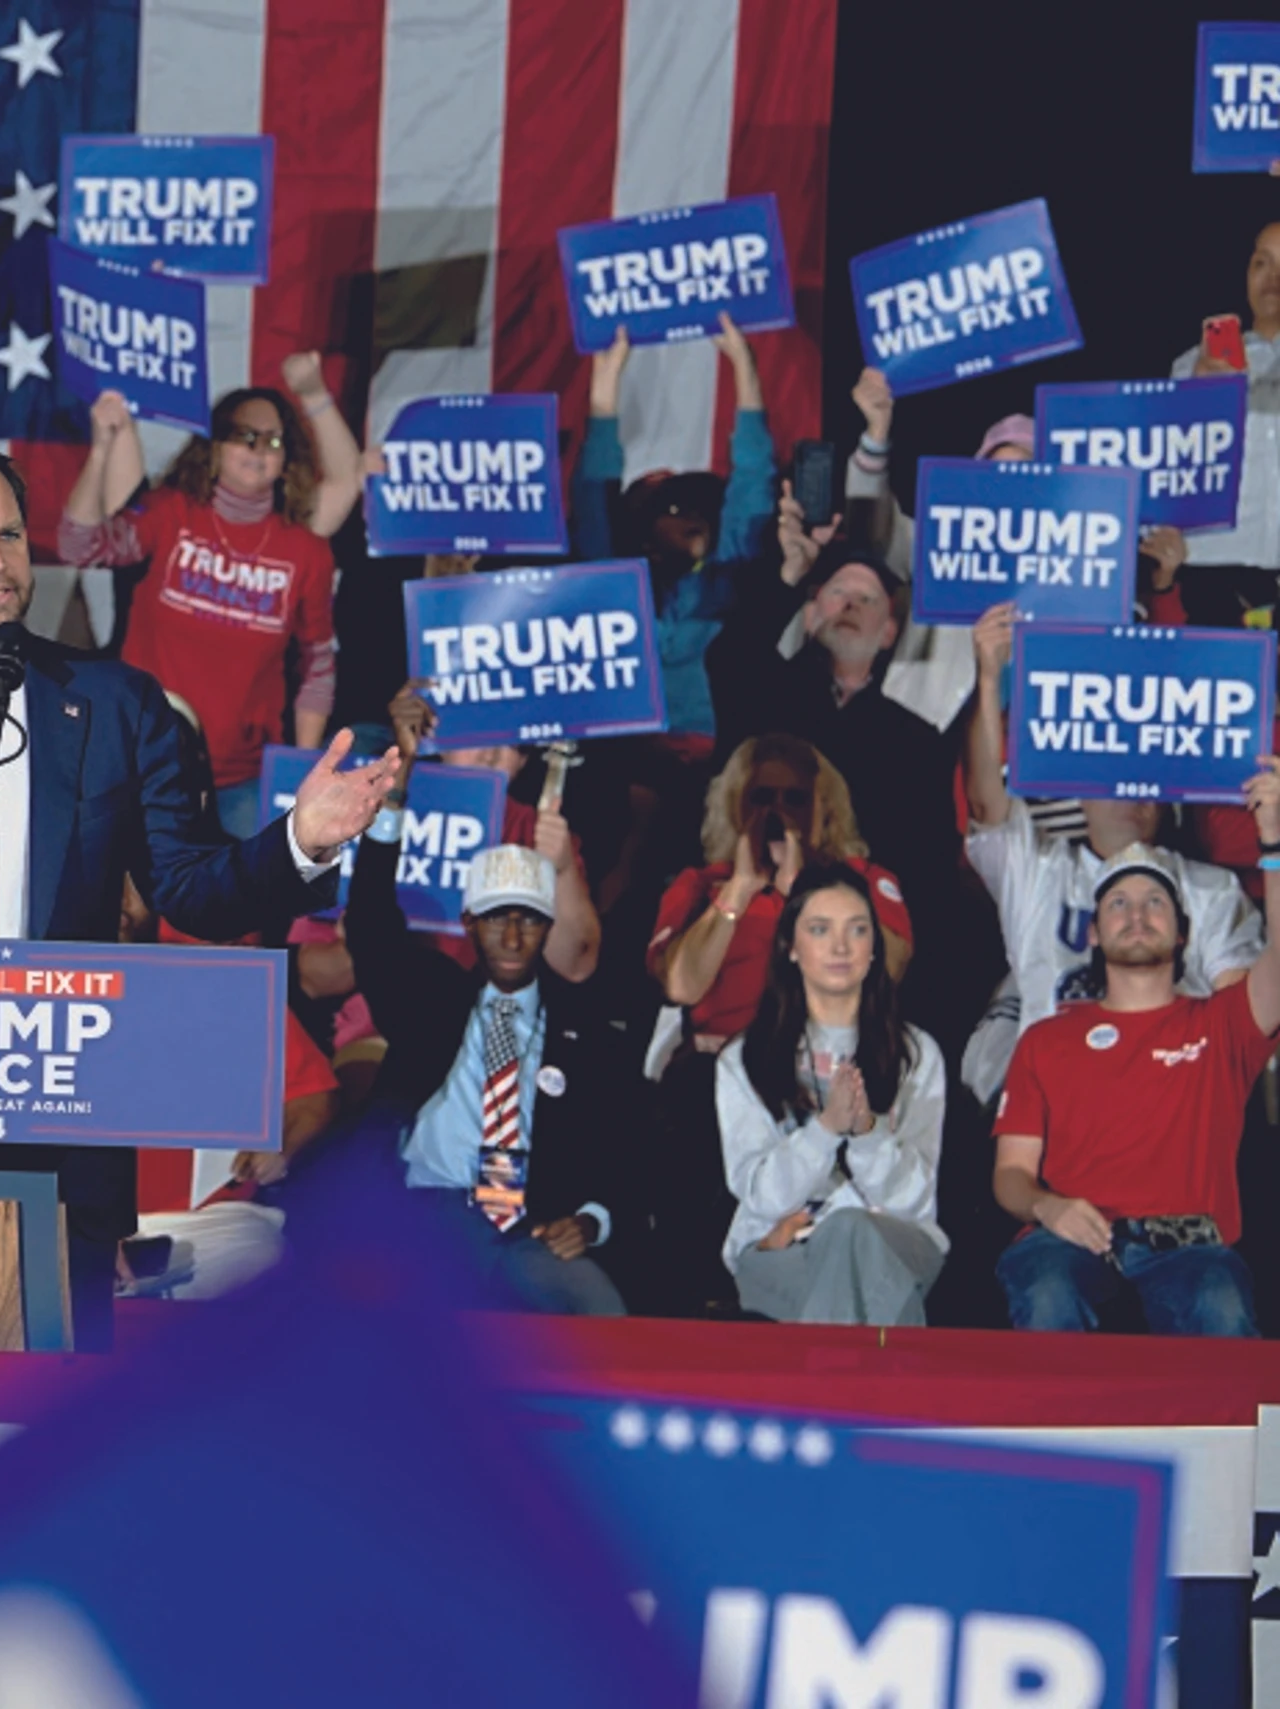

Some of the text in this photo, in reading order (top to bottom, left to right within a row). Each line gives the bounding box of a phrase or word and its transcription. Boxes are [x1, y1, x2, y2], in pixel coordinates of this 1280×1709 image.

[75, 178, 258, 219] TRUMP
[75, 218, 254, 245] WILL FIX IT
[576, 233, 768, 292] TRUMP
[584, 268, 769, 318] WILL FIX IT
[866, 247, 1043, 331] TRUMP
[57, 284, 196, 358] TRUMP
[872, 287, 1050, 359] WILL FIX IT
[118, 349, 166, 383] FIX
[171, 360, 197, 390] IT
[382, 440, 545, 484] TRUMP
[1050, 420, 1233, 469] TRUMP
[381, 483, 546, 512] WILL FIX IT
[1149, 464, 1229, 498] FIX IT
[929, 505, 1121, 556] TRUMP
[178, 540, 288, 593] TRUMP
[929, 551, 1117, 588] WILL FIX IT
[422, 611, 637, 675] TRUMP
[430, 657, 640, 705] WILL FIX IT
[1029, 671, 1256, 726] TRUMP
[1029, 719, 1251, 758] WILL FIX IT
[395, 854, 433, 886] IX
[25, 970, 75, 995] FIX
[84, 973, 113, 996] IT
[31, 1100, 92, 1114] AGAIN!
